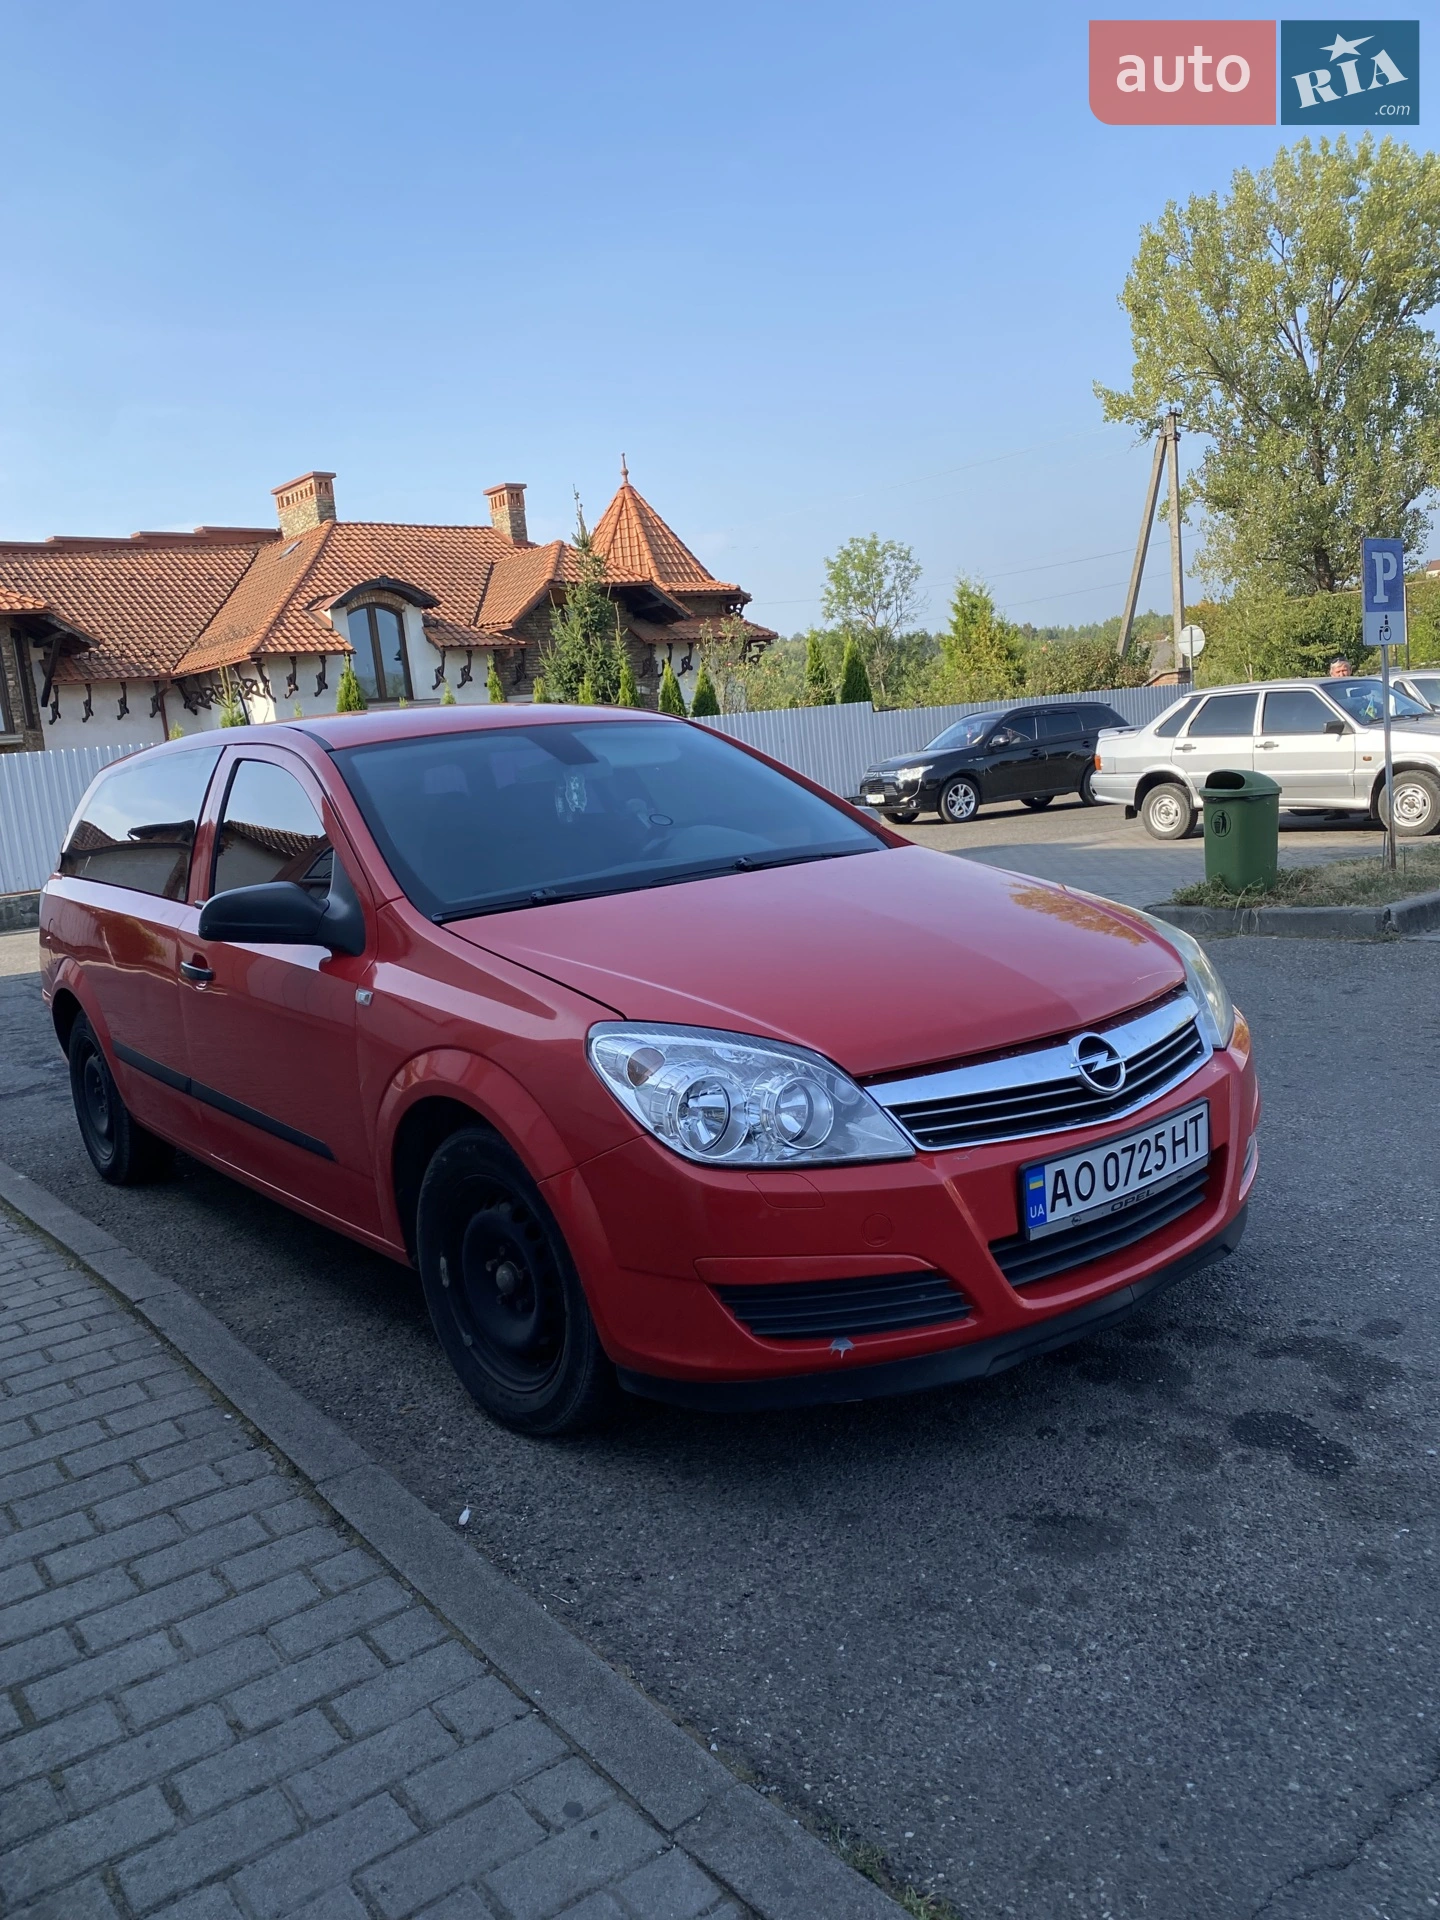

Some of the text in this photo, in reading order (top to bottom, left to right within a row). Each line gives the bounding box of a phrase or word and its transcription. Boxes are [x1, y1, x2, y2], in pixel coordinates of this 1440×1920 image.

[1371, 551, 1398, 603] P
[1030, 1204, 1045, 1219] UA
[1110, 1189, 1155, 1212] OPEL
